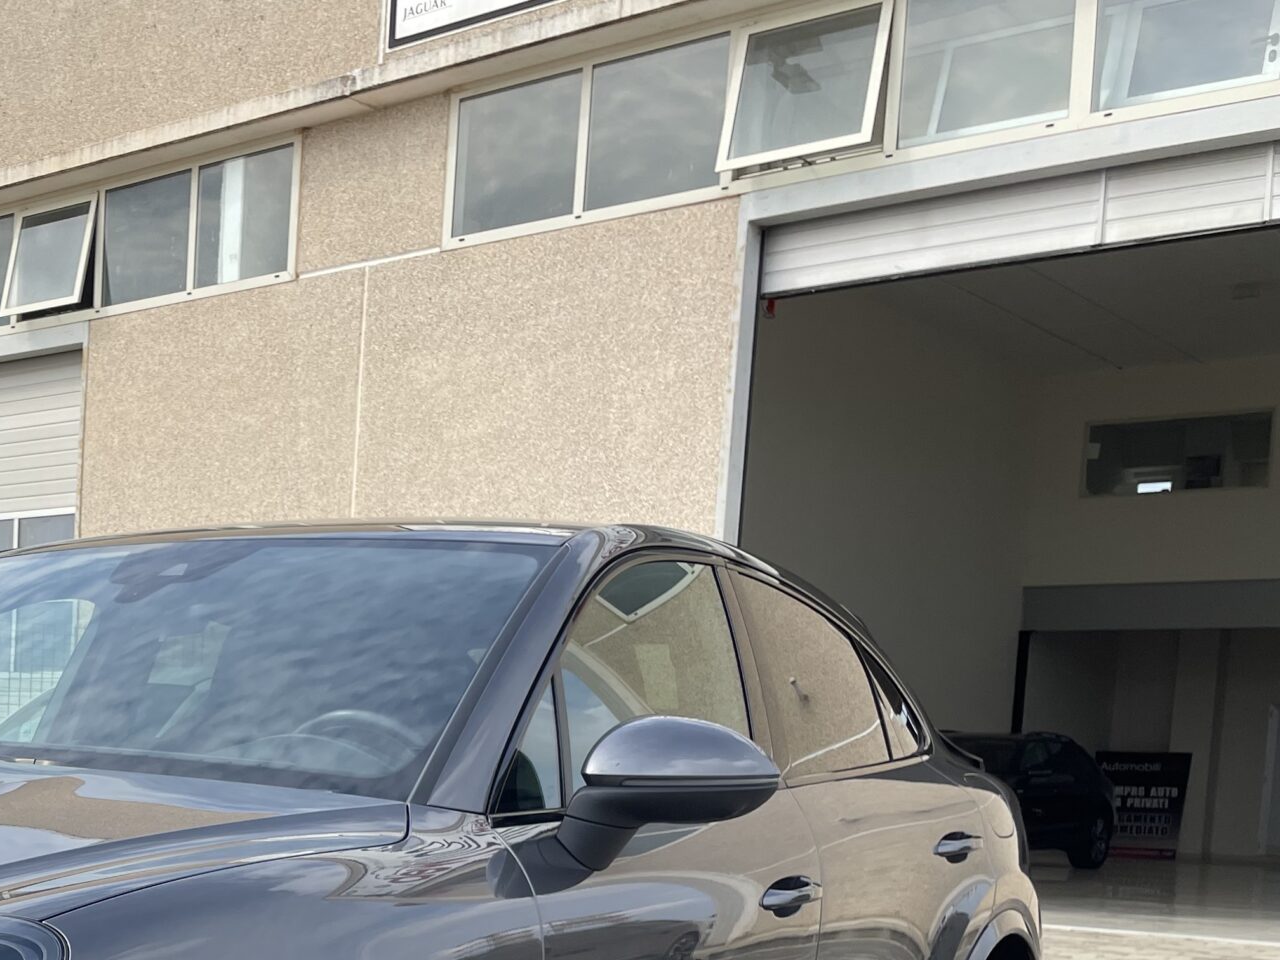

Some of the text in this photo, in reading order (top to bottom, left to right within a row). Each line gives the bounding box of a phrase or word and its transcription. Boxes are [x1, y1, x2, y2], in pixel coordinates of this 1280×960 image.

[403, 0, 446, 22] JAGUAR
[1114, 786, 1178, 798] MPRO AUTO
[1126, 797, 1169, 809] PRIVATI
